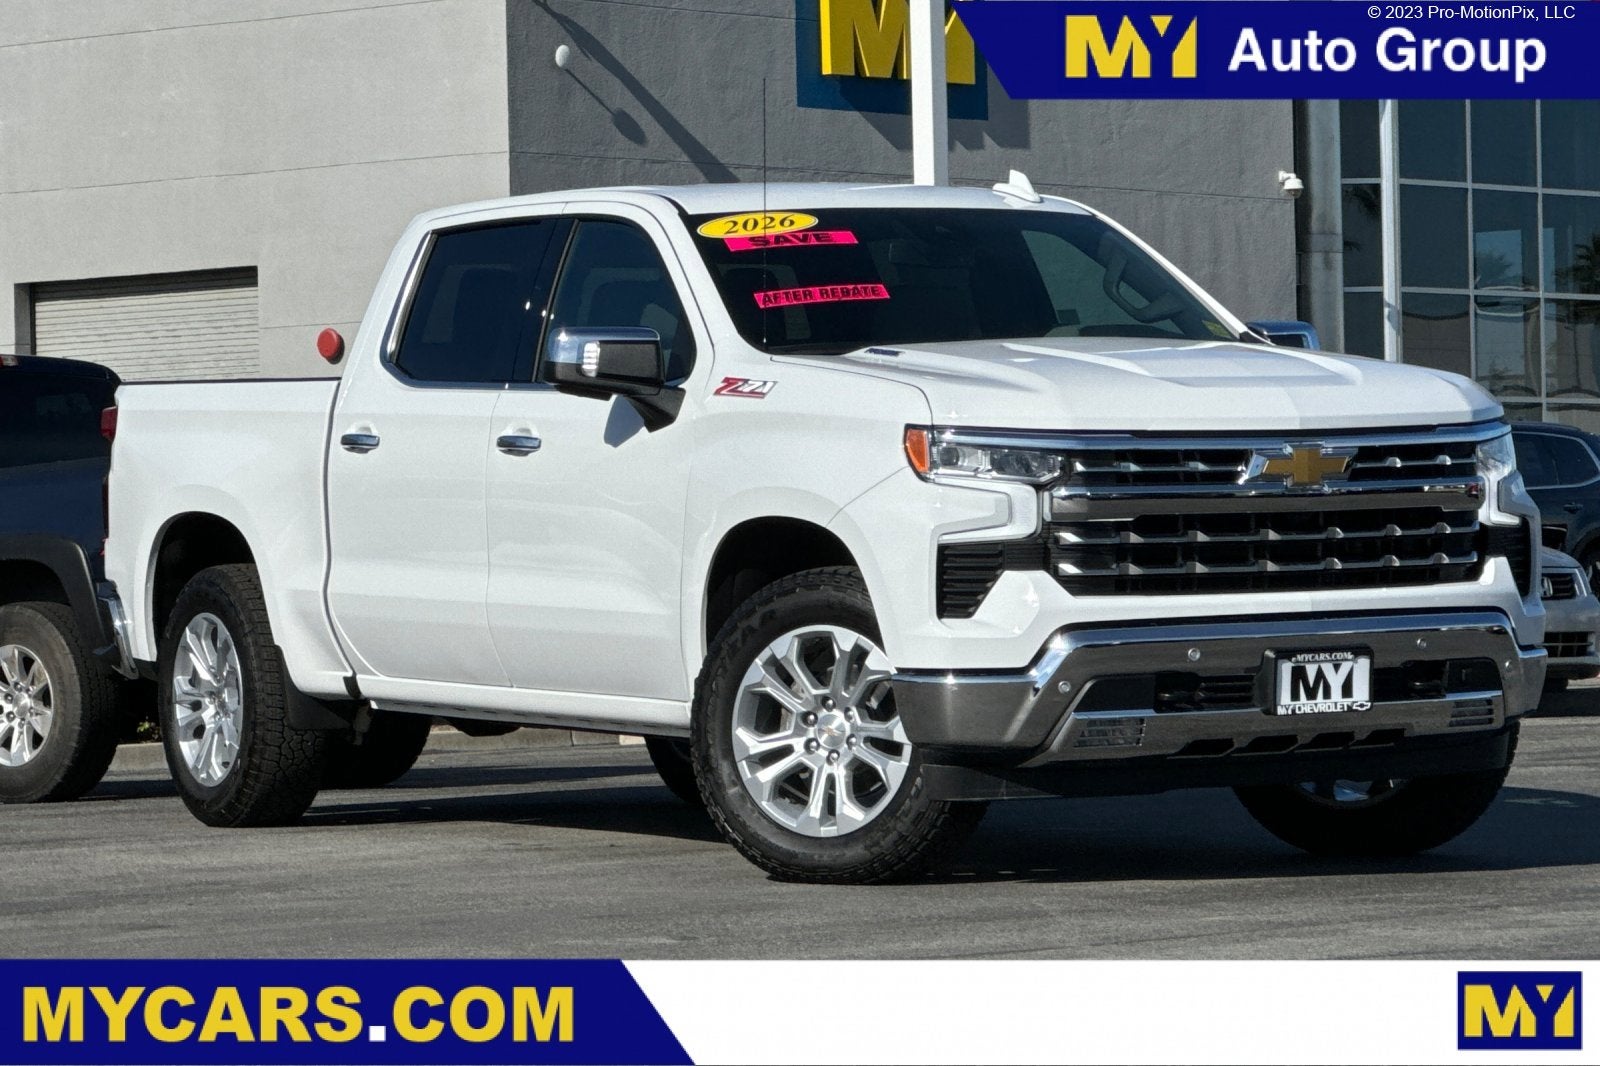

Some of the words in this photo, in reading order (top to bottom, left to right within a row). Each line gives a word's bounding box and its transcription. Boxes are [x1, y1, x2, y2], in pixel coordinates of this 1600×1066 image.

[723, 213, 796, 235] 2026
[750, 232, 832, 247] SAVE
[762, 289, 814, 306] AFTER
[819, 285, 881, 300] REBATE
[713, 377, 777, 399] Z71
[1290, 663, 1354, 702] MY
[1277, 705, 1293, 715] MY
[1295, 702, 1348, 713] CHEVROLET
